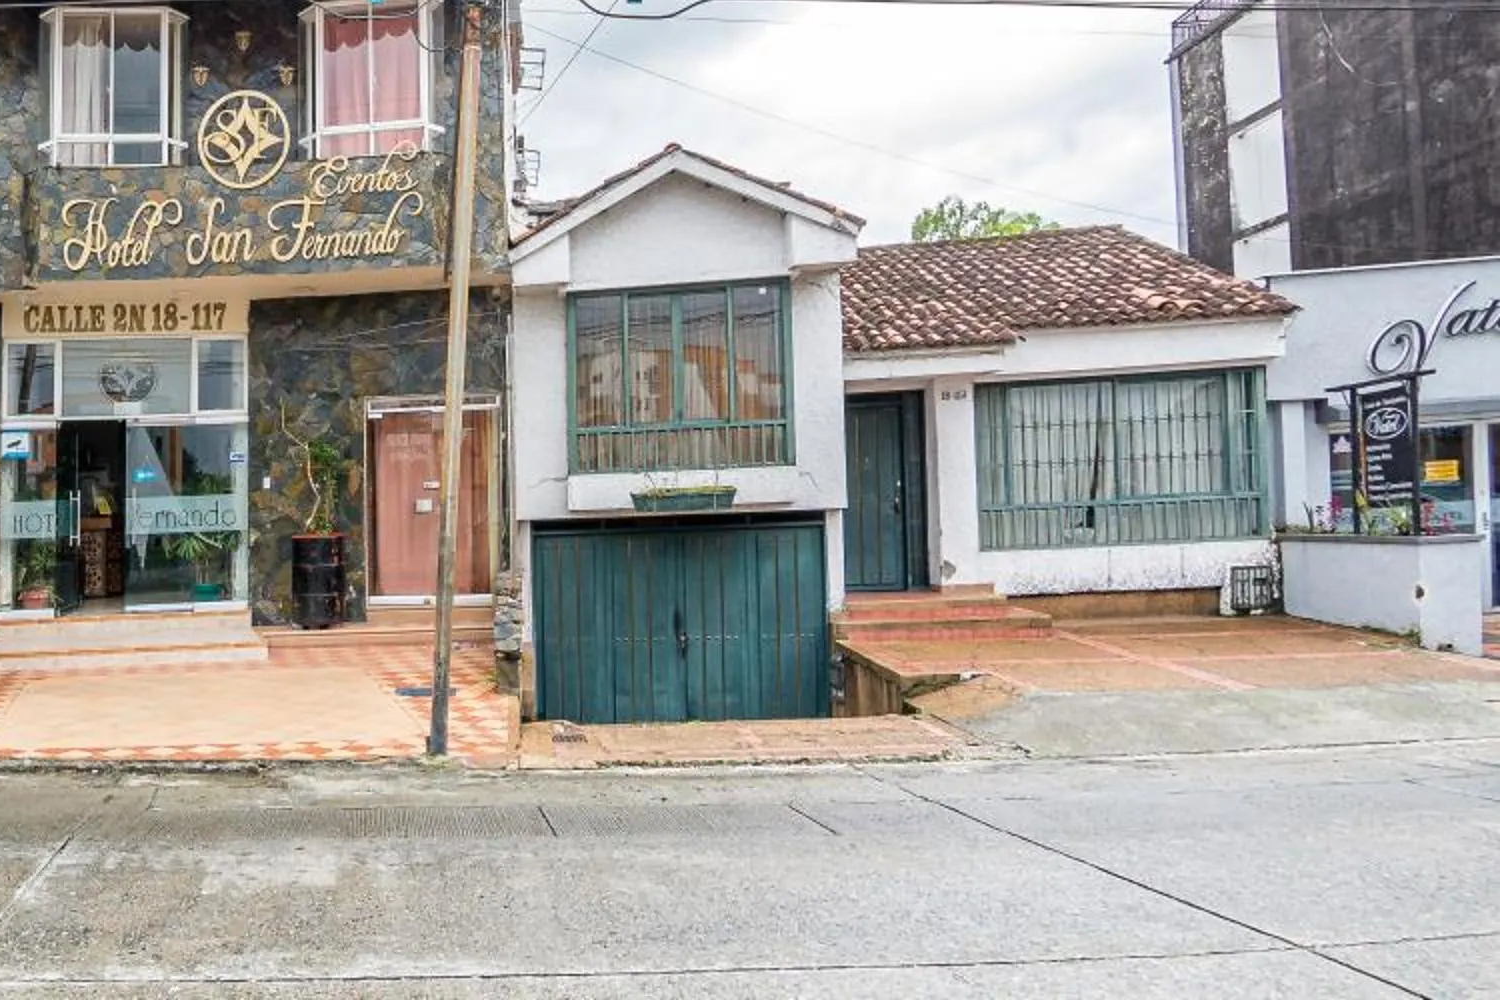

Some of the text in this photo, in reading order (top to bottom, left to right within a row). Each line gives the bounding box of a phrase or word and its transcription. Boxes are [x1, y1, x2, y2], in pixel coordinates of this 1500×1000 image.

[309, 139, 422, 199] Eventos
[61, 191, 424, 271] Hotel San Fernando
[23, 302, 227, 333] CALLE 2N 18-117
